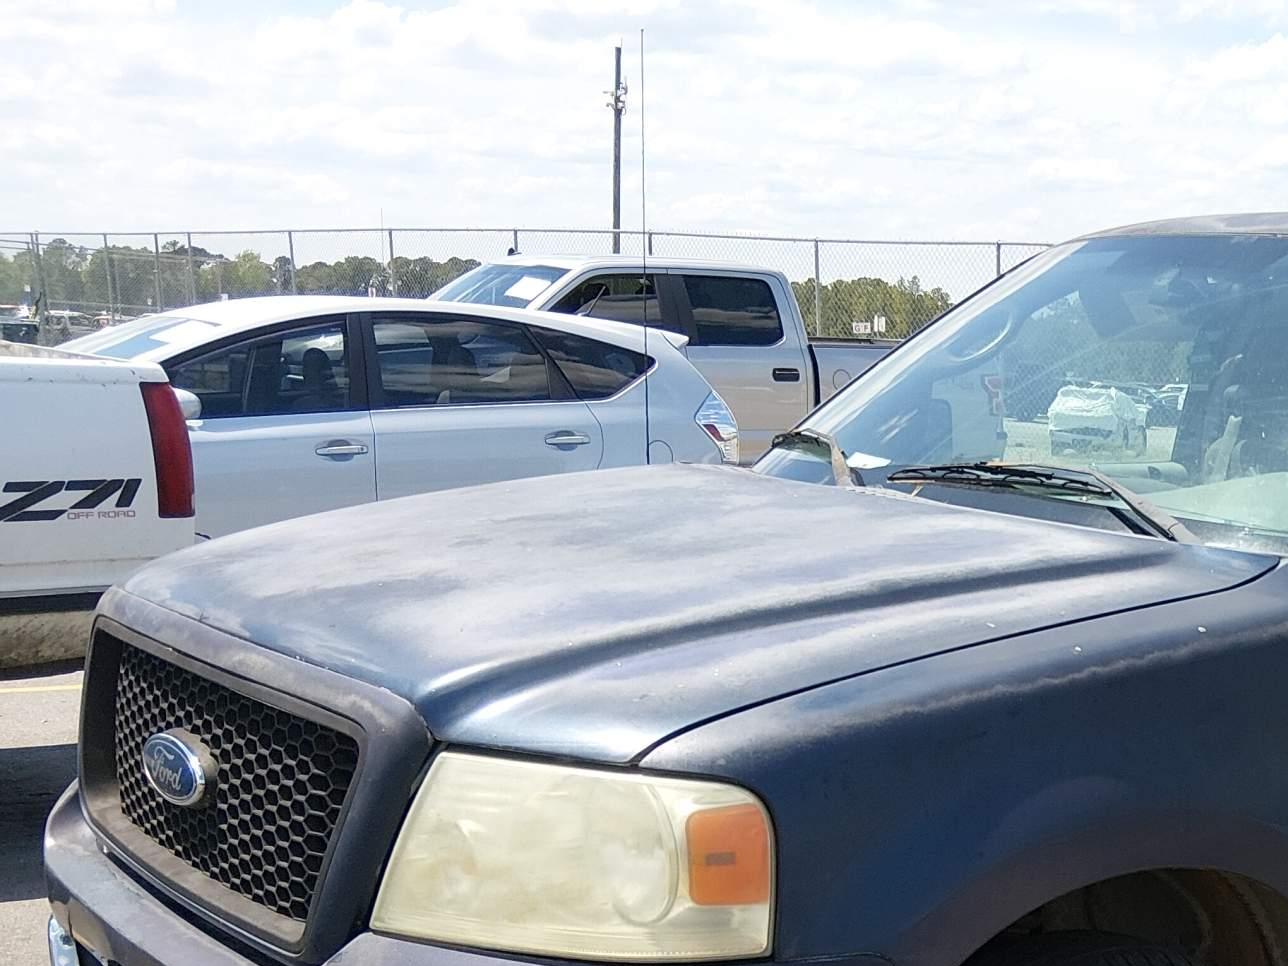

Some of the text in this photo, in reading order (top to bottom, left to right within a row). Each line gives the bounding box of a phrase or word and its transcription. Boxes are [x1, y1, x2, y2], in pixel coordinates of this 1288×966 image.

[0, 478, 142, 522] Z71
[67, 510, 136, 520] OFF ROAD
[152, 746, 182, 790] Ford
